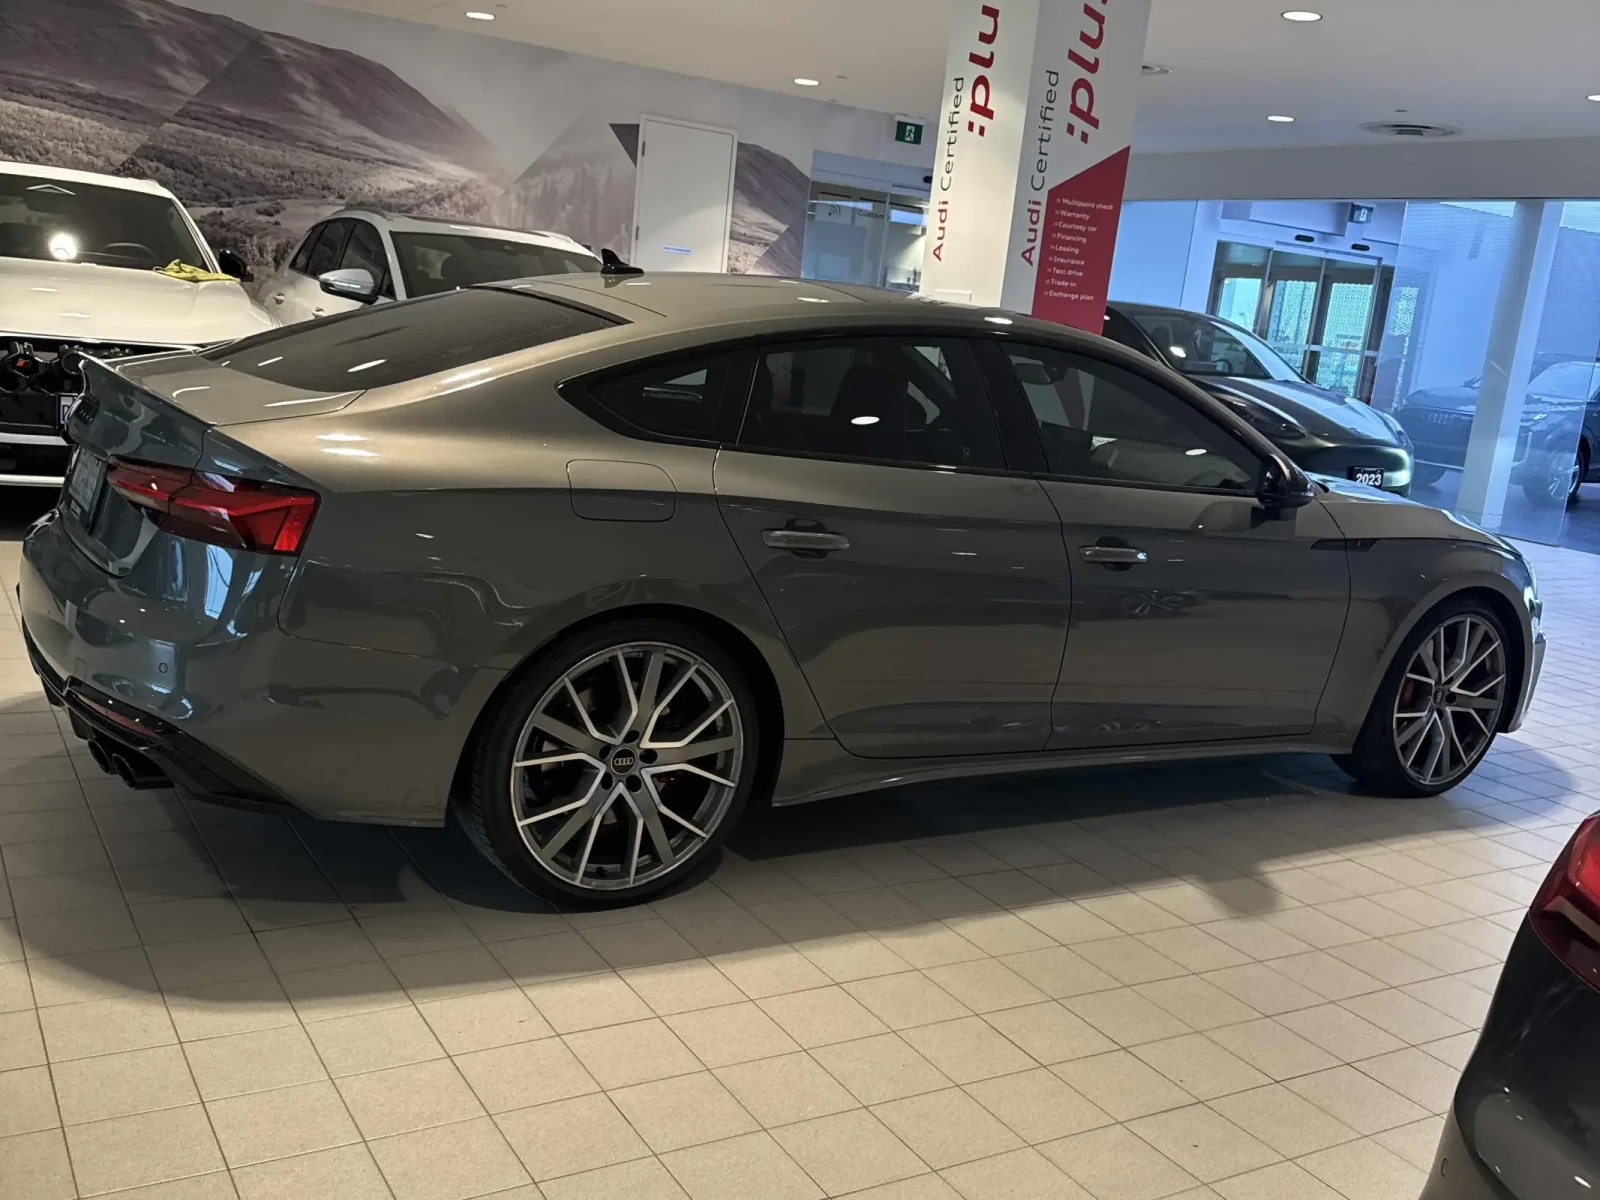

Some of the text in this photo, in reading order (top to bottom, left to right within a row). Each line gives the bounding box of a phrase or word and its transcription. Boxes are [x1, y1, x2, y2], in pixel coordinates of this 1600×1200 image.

[1066, 0, 1107, 145] :plu
[932, 77, 964, 262] Audi Certified
[1021, 70, 1059, 266] Audi Certified
[1062, 198, 1113, 210] Multipoint check
[1060, 210, 1090, 220] Warranty
[1058, 221, 1086, 232] Courtesy
[1057, 233, 1087, 243] Financing
[1055, 245, 1079, 254] Leasing
[1053, 256, 1085, 265] Insurance
[1052, 267, 1083, 277] Test drive
[1051, 279, 1077, 287] Trade-in
[1049, 290, 1079, 300] Exchange
[1356, 473, 1382, 486] 2023
